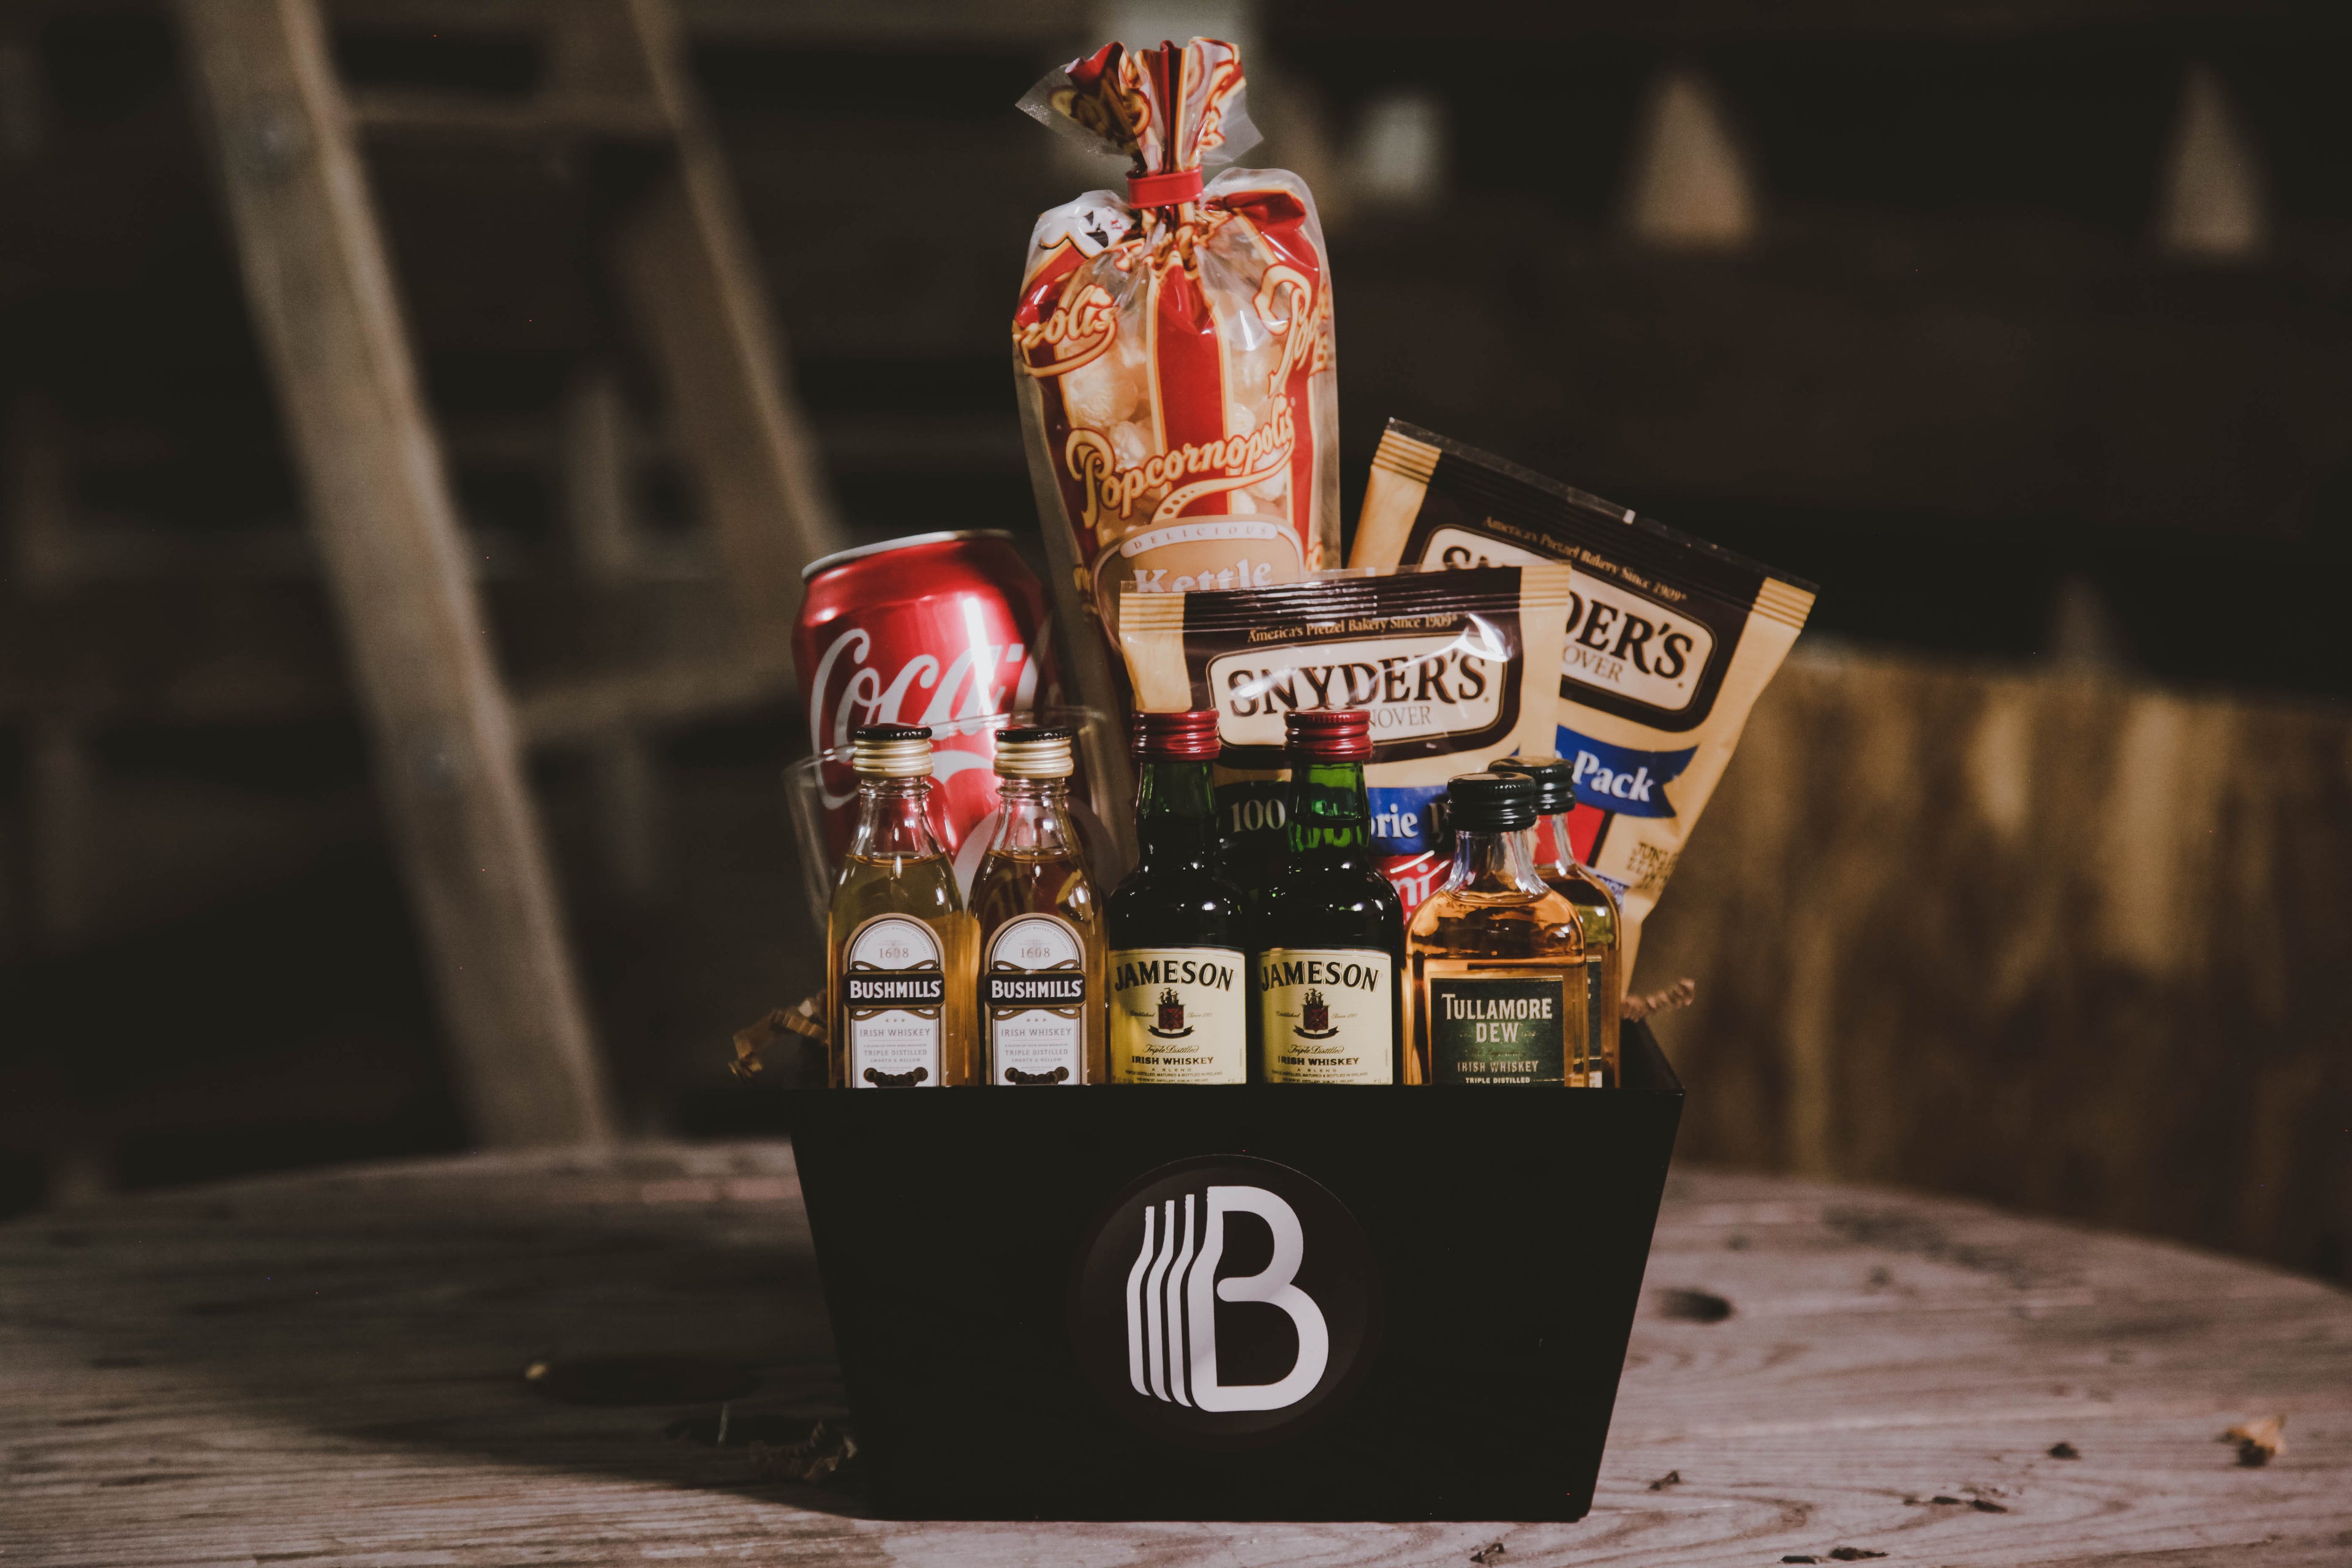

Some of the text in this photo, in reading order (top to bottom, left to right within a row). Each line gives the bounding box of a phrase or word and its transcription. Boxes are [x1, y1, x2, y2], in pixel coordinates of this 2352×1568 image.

[1066, 394, 1295, 528] Popcornopolis
[1134, 527, 1267, 549] DELICIOUS
[1133, 559, 1272, 593] Kettle
[1247, 626, 1303, 643] America's
[1306, 619, 1345, 636] Pretzel
[1348, 617, 1387, 633] Bakery
[1390, 617, 1420, 629] Since
[1228, 650, 1487, 717] SNYDER'S
[1368, 705, 1432, 728] NOVER
[1572, 749, 1656, 802] Pack
[1230, 799, 1286, 833] 100
[879, 947, 909, 959] 1608
[1020, 947, 1050, 959] 1608
[1114, 960, 1234, 992] JAMESON
[1262, 960, 1378, 992] JAMESON
[850, 980, 941, 998] BUSHMILLS
[992, 980, 1082, 998] BUSHMILLS
[1441, 993, 1553, 1020] TULLAMORE
[1029, 1028, 1071, 1036] WHISKEY
[1132, 1055, 1214, 1065] IRISH WHISKEY
[1143, 1044, 1199, 1055] Triple Distilled
[1287, 1044, 1344, 1055] Triple Distilled
[1278, 1056, 1360, 1066] IRISH WHISKEY
[1457, 1061, 1539, 1072] IRISH WHISKEY
